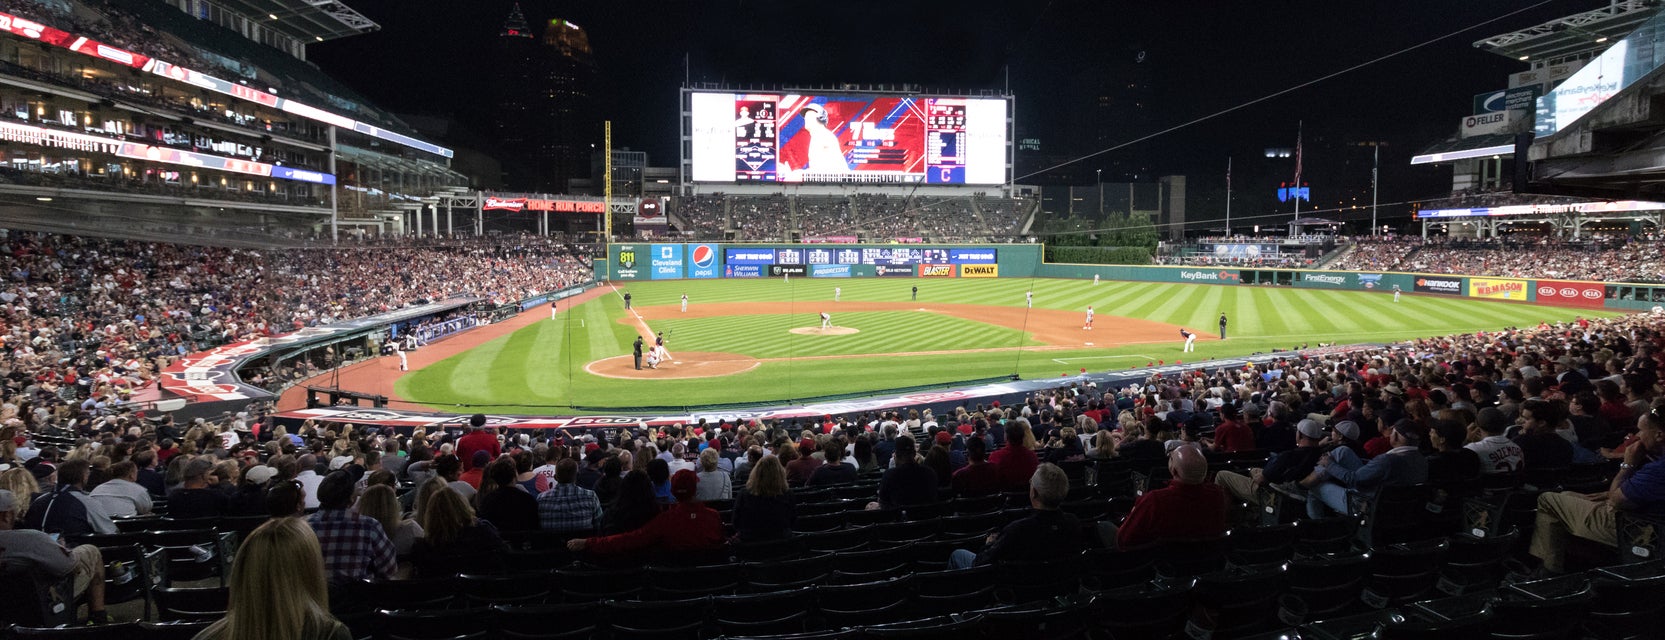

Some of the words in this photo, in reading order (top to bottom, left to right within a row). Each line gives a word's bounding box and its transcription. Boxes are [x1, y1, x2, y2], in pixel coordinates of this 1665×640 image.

[1477, 113, 1504, 126] FELLER
[940, 168, 951, 182] C
[486, 199, 523, 208] Budweiser
[528, 201, 553, 211] HOME
[556, 202, 574, 211] RUN
[576, 202, 605, 213] PORCH
[620, 252, 635, 263] 811
[694, 269, 712, 277] pepsi
[923, 266, 950, 276] BLASTER
[1181, 271, 1218, 280] KeyBank
[1305, 274, 1345, 285] FirstEnergy
[1561, 288, 1577, 296] KIA
[1584, 290, 1600, 298] KIA
